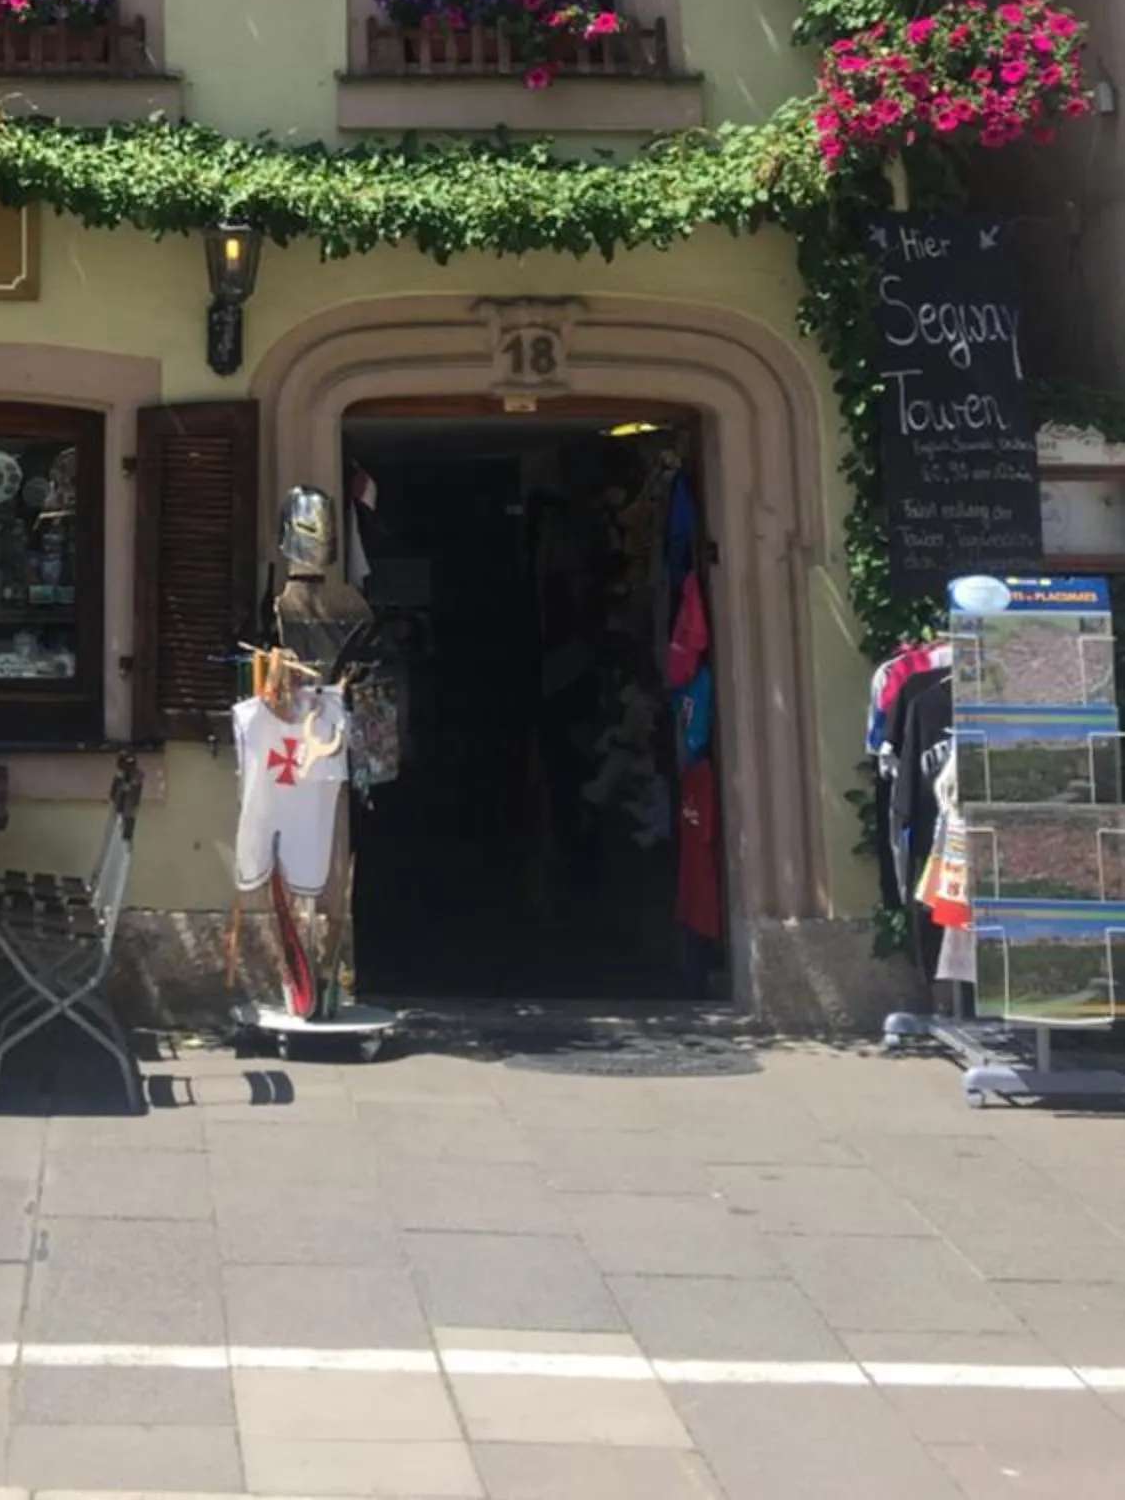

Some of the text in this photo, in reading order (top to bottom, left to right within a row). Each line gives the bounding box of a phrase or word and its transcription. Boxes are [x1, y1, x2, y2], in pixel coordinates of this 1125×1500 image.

[900, 226, 951, 260] Hier
[502, 333, 557, 375] 18
[880, 275, 1023, 379] Segway
[880, 369, 1007, 435] Touren
